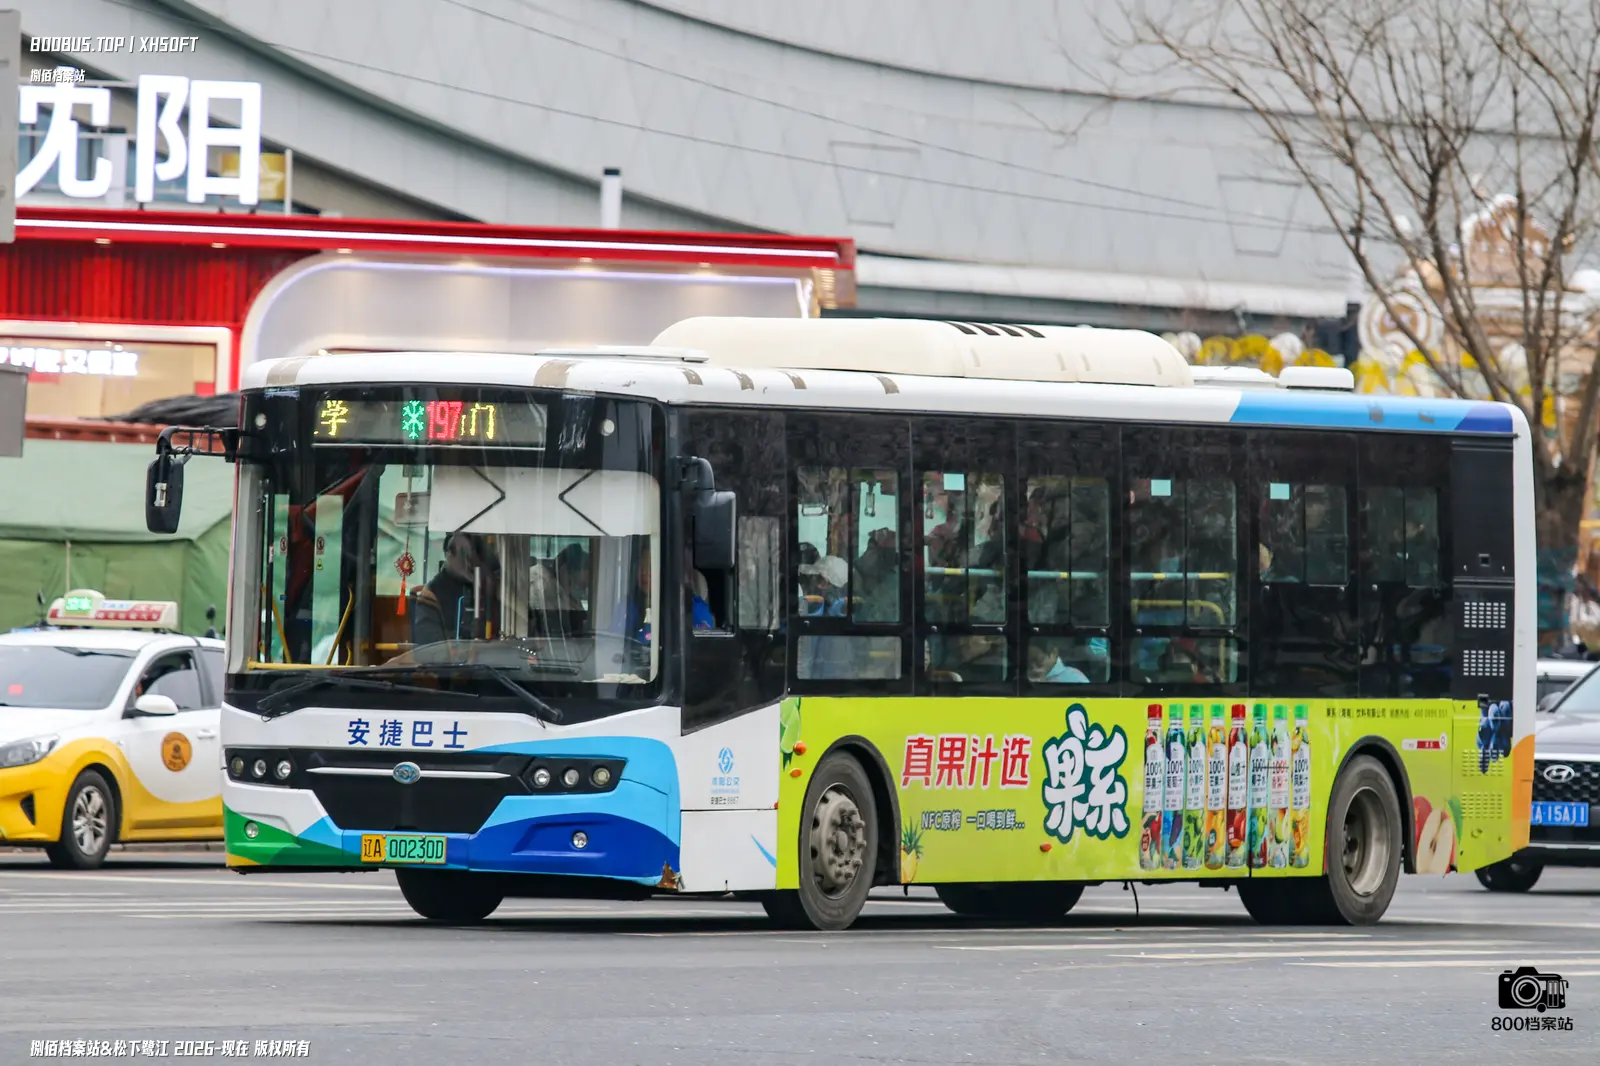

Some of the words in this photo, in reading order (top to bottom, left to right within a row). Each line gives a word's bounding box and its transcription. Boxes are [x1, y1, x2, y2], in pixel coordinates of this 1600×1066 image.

[426, 400, 463, 439] 197
[347, 718, 468, 749] 安捷巴士
[901, 736, 1031, 788] 真果汁选
[363, 838, 382, 858] 辽A
[389, 838, 444, 859] 00230D
